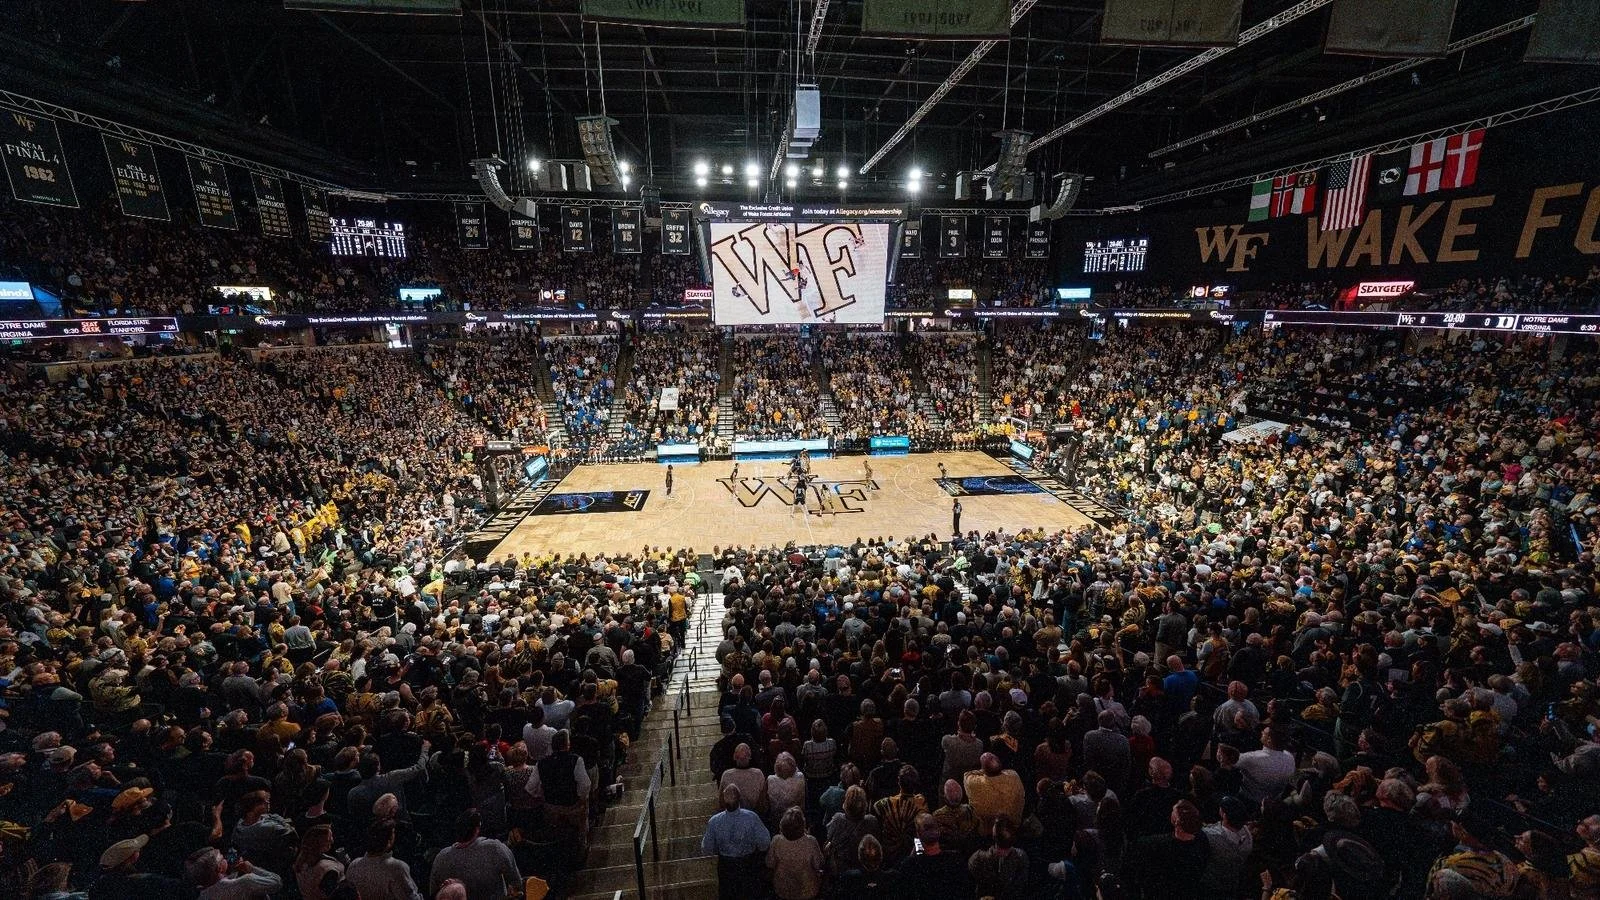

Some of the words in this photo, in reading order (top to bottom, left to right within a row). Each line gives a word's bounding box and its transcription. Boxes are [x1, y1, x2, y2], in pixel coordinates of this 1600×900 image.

[6, 144, 50, 162] FINAL
[53, 154, 59, 164] 4
[24, 164, 56, 182] 1962
[117, 168, 148, 182] ELITE
[196, 185, 220, 196] SWEET
[703, 206, 729, 218] Allegacy
[572, 229, 583, 240] 12
[669, 232, 682, 243] 32
[1307, 195, 1496, 270] WAKE
[950, 236, 957, 247] 3
[1196, 224, 1270, 272] WF
[711, 223, 862, 317] WF
[1361, 284, 1410, 293] SEATGEEK
[1401, 315, 1416, 325] WF
[1443, 314, 1465, 323] 20:00
[716, 474, 880, 514] WF
